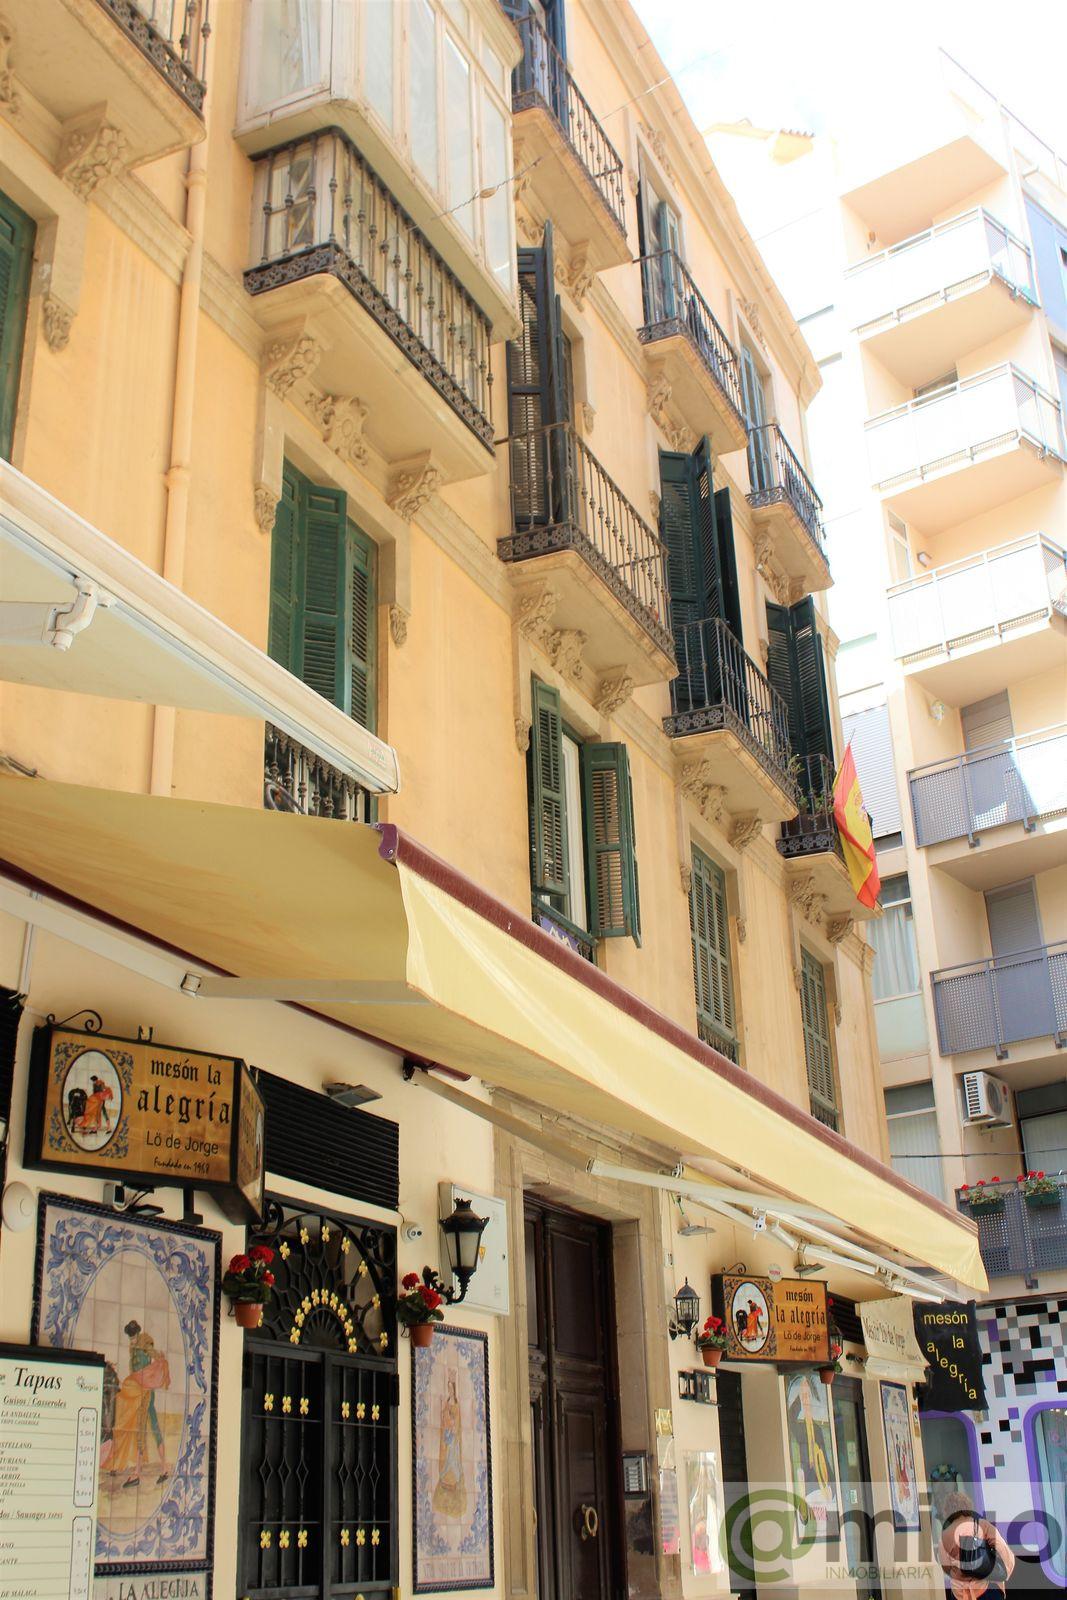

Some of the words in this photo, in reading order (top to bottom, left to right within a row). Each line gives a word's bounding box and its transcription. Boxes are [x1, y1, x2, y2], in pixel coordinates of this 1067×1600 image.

[151, 1059, 199, 1082] mesón
[207, 1064, 221, 1085] la
[137, 1084, 230, 1124] alegría
[165, 1134, 181, 1149] de
[185, 1136, 219, 1157] Jorge
[785, 1288, 814, 1302] mesón
[775, 1304, 786, 1323] la
[790, 1305, 826, 1327] alegría
[923, 1311, 968, 1325] mesón
[793, 1331, 801, 1341] de
[802, 1331, 821, 1344] Jorge
[952, 1335, 965, 1349] la
[14, 1367, 62, 1394] Tapas
[926, 1342, 977, 1399] alegría
